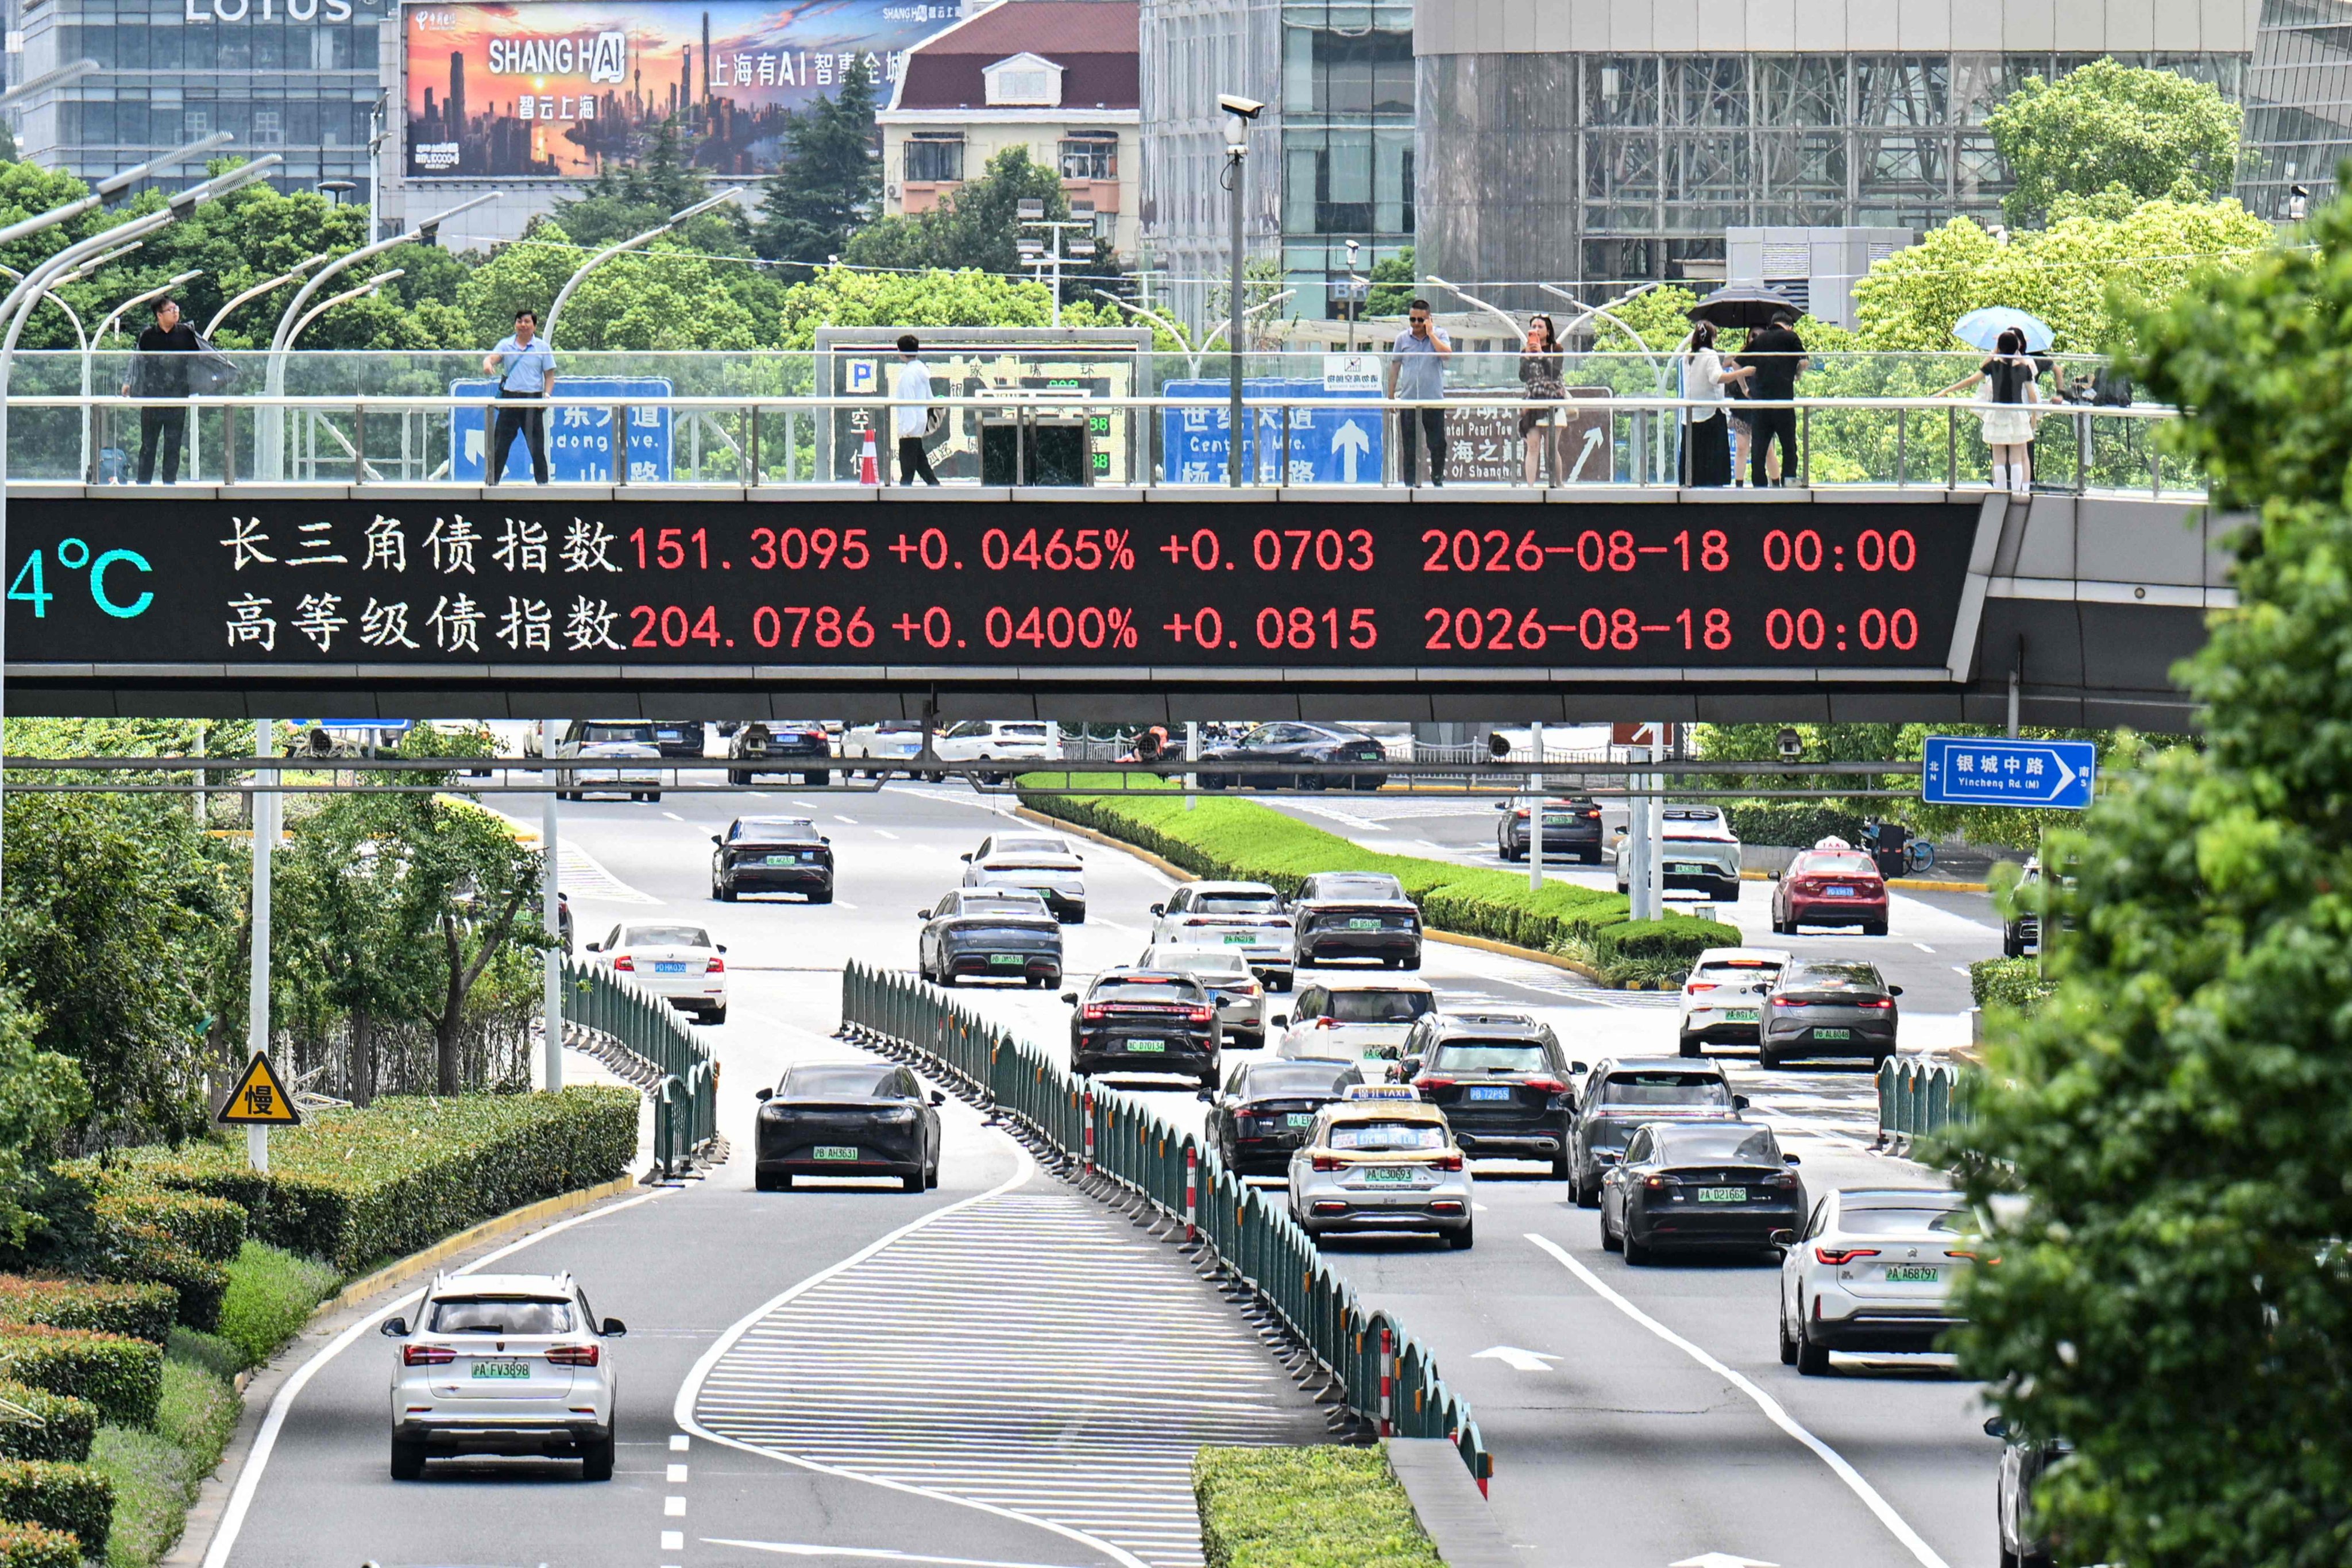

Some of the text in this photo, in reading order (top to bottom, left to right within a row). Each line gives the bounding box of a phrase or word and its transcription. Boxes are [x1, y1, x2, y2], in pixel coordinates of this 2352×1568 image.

[519, 95, 594, 120] 智云上海
[854, 364, 871, 387] P
[1469, 422, 1493, 437] Pearl
[626, 436, 659, 448] ve.
[1469, 465, 1522, 480] Shanghi
[220, 514, 623, 574] 长三角债指数
[1422, 529, 1729, 571] 2026-08-18
[1763, 530, 1916, 571] 00:00
[226, 592, 627, 652] 高等级债指数
[1424, 608, 1732, 650] 2026-08-18
[1766, 608, 1918, 650] 00:00
[1929, 760, 1940, 772] 北
[1956, 754, 2045, 775] 银城中路
[2079, 766, 2090, 778] 南
[1930, 774, 1937, 782] N
[1958, 777, 2040, 790] Yincheng Rd. (M)
[2080, 779, 2087, 787] S
[244, 1084, 273, 1115] 慢
